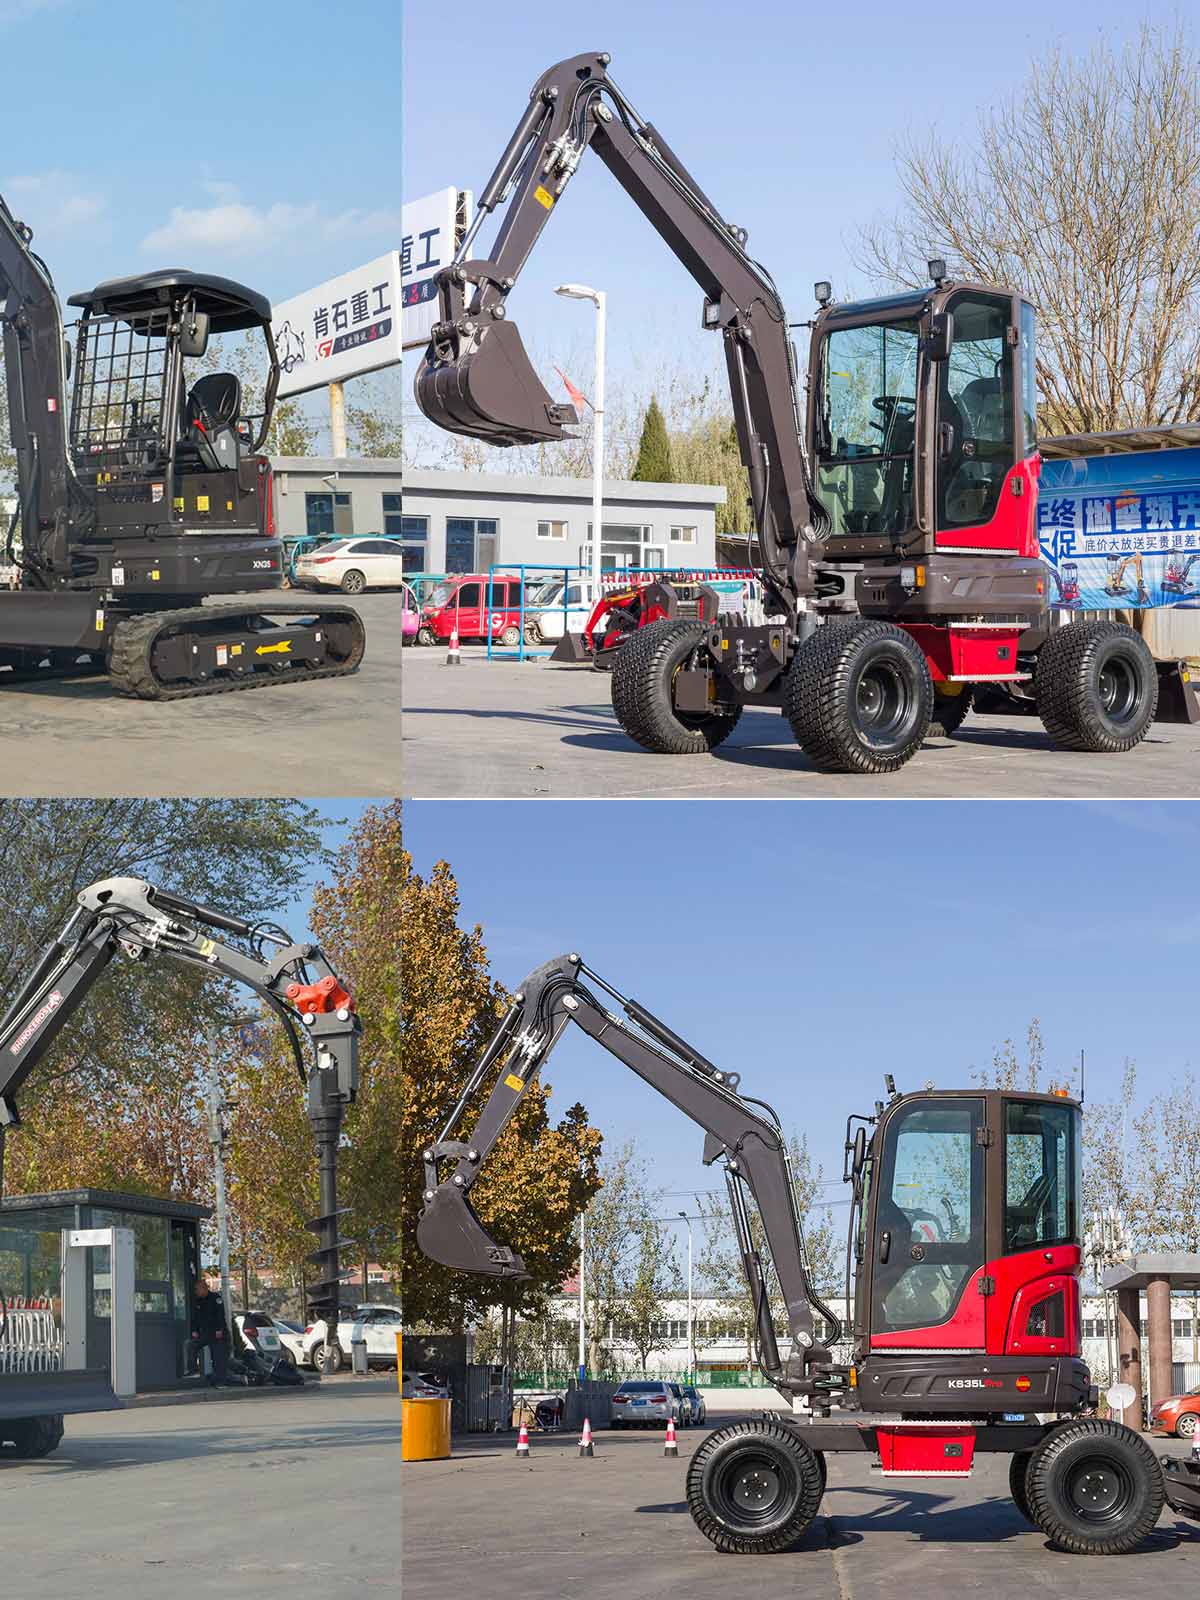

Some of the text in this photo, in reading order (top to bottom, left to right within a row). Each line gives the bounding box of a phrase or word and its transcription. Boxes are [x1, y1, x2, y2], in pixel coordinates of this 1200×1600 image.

[312, 281, 392, 339] 肯石重工
[1084, 534, 1200, 553] 底价大放送买贵退差
